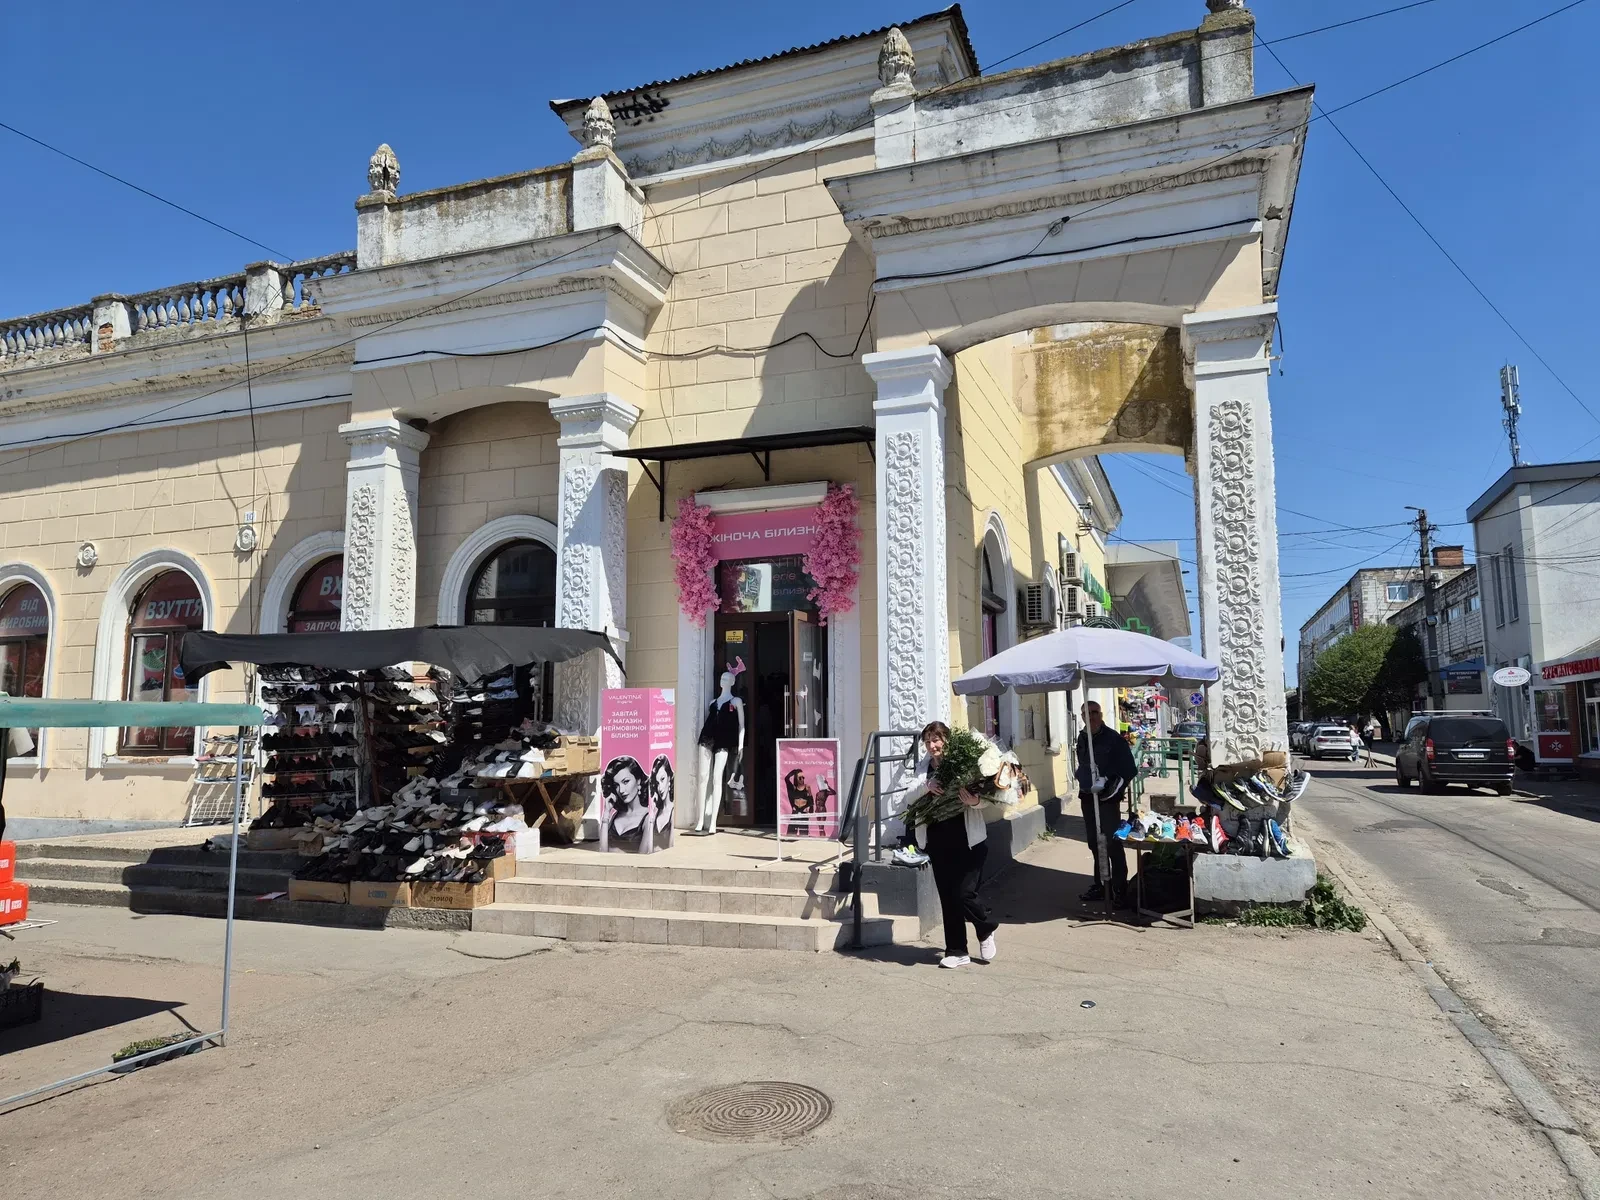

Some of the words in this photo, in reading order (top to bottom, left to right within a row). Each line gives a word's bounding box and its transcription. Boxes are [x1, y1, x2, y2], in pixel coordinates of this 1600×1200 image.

[711, 531, 760, 543] ЖІНОЧА
[20, 598, 40, 613] ВІД
[145, 599, 203, 620] ВЗУТТЯ
[603, 724, 647, 732] НЕЙМОВІРНОЇ
